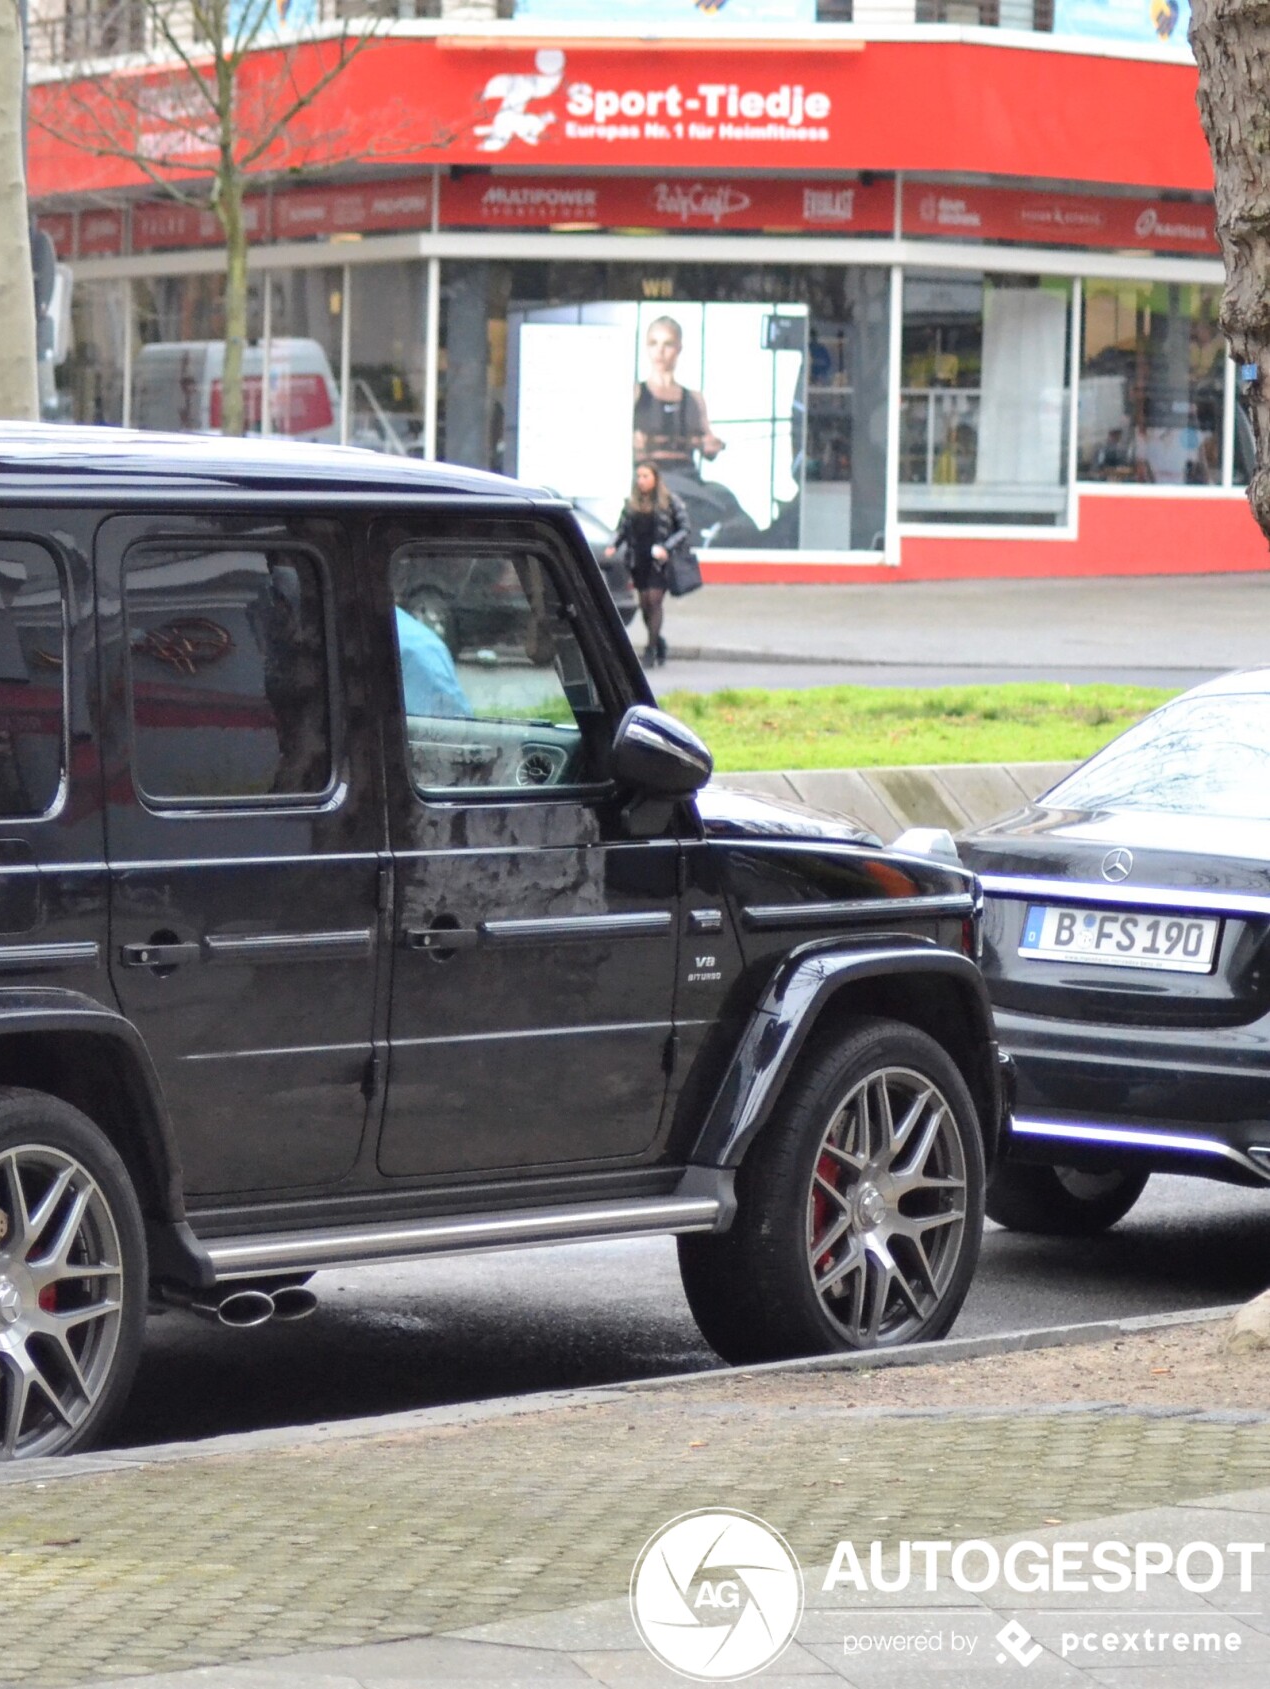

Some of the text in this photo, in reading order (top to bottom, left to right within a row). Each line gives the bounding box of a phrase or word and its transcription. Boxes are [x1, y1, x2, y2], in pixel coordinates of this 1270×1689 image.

[566, 83, 830, 126] Sport-Tiedje
[565, 122, 640, 141] Europas
[674, 124, 683, 138] 1
[688, 123, 714, 139] für
[719, 123, 829, 141] Heimfitness
[1054, 912, 1076, 946] B
